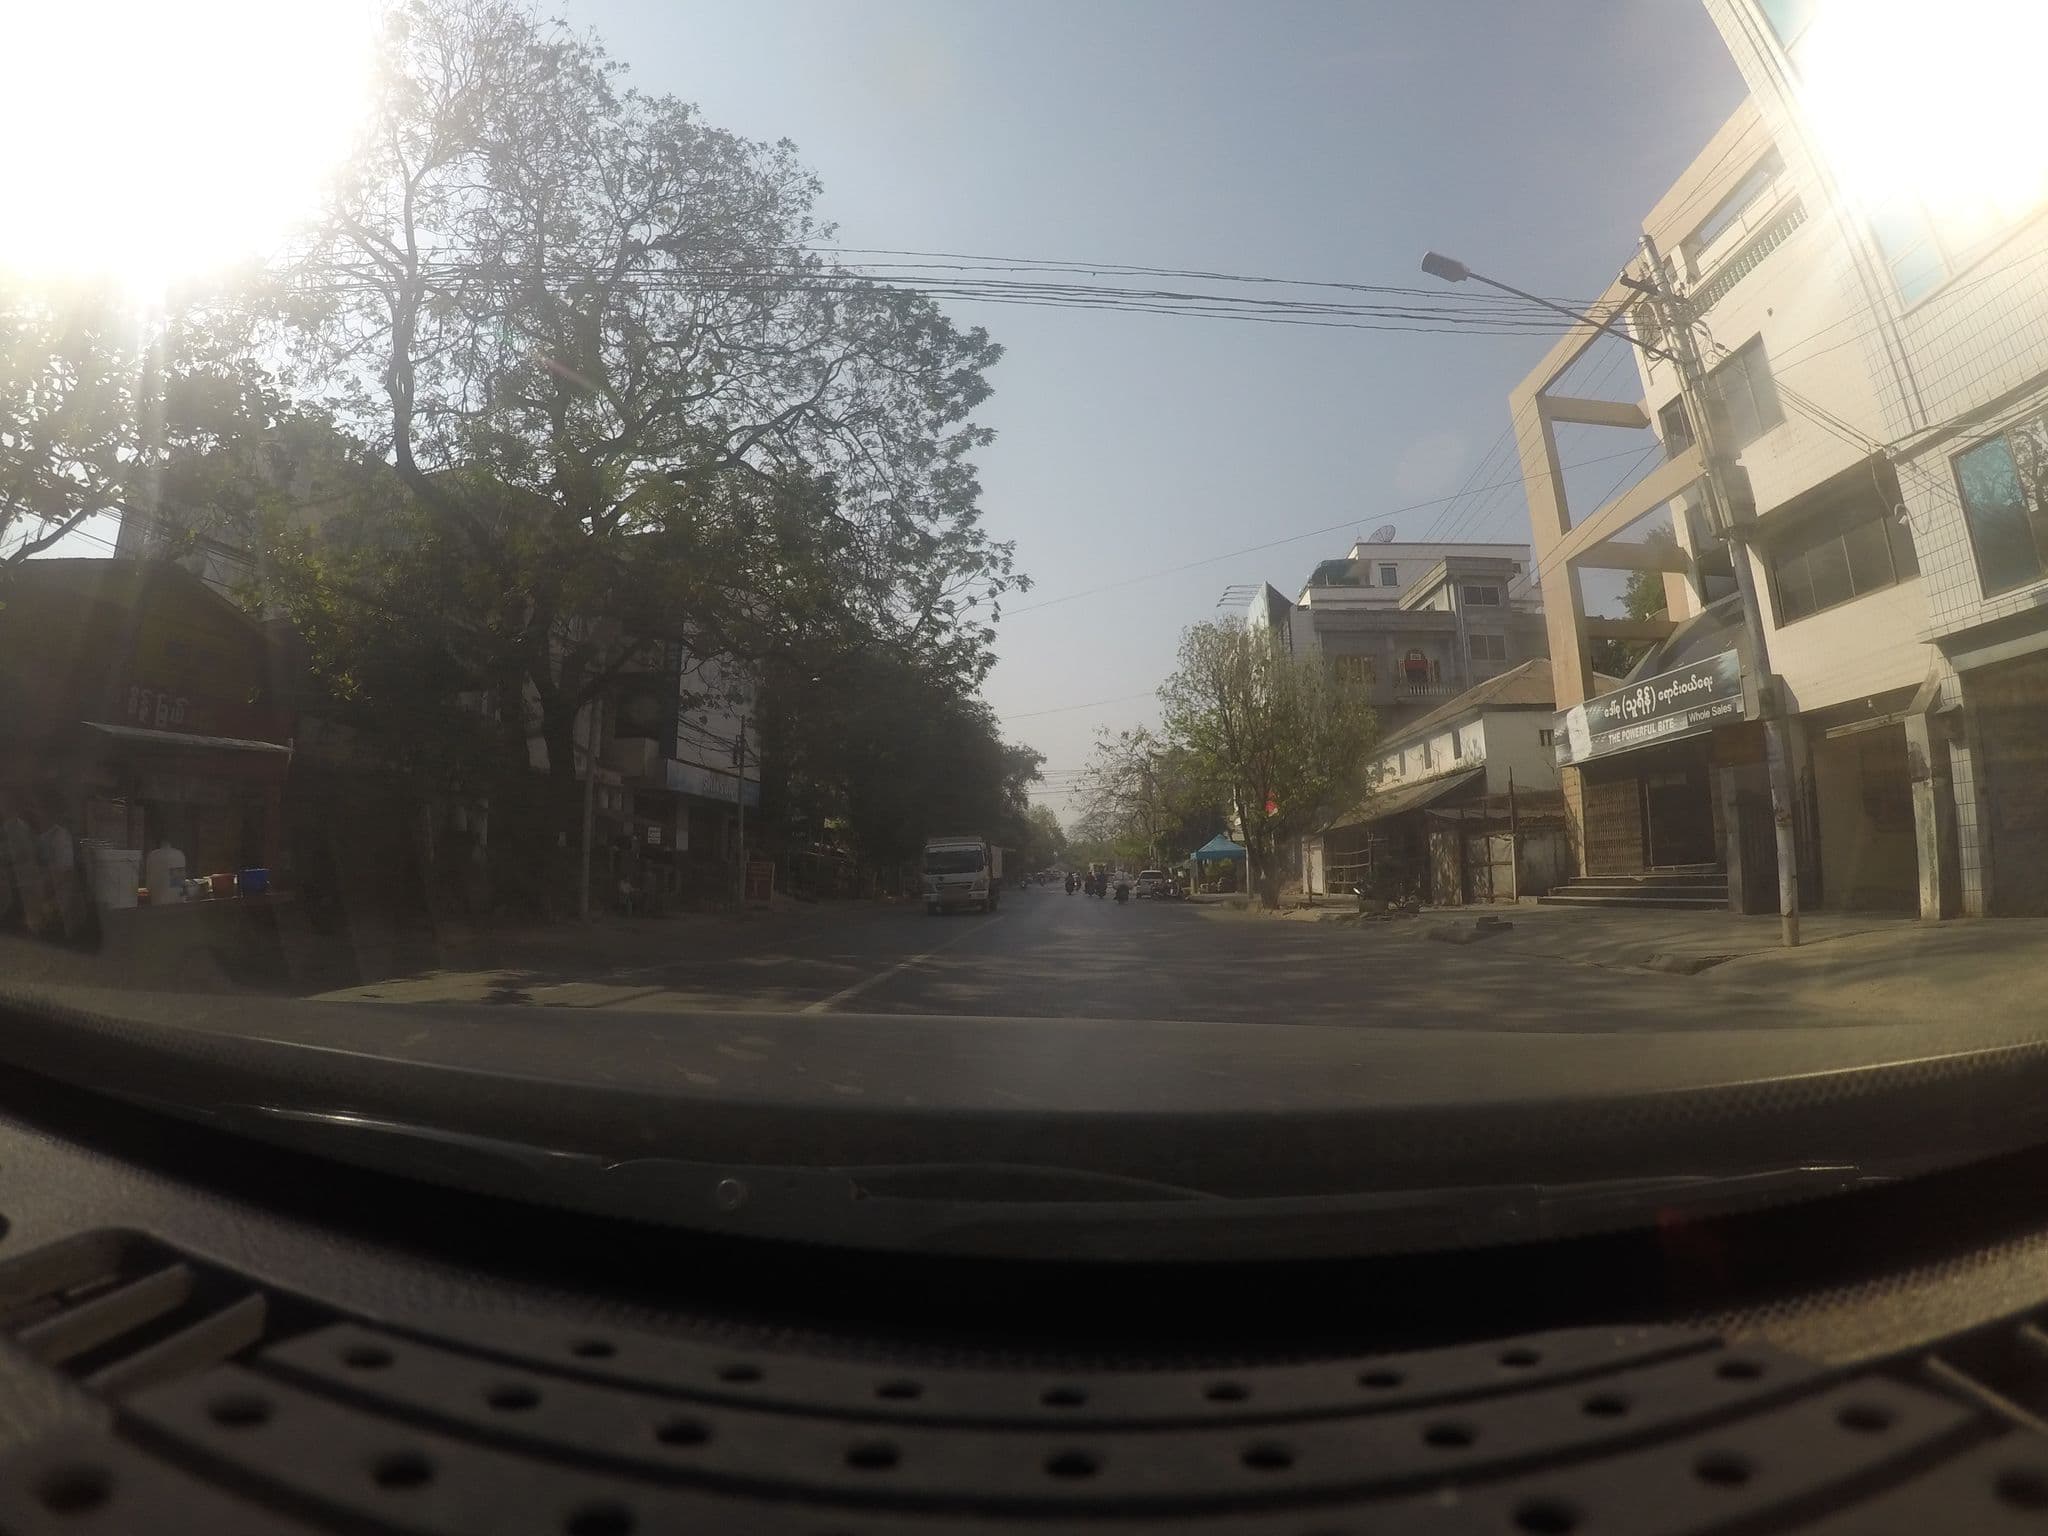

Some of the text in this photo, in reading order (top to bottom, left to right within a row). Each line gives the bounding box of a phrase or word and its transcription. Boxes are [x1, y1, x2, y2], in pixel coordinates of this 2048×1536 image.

[1688, 703, 1732, 723] Whole Sales
[1608, 731, 1621, 745] THE
[1621, 723, 1656, 742] POWERFUL
[1657, 717, 1674, 732] BITE
